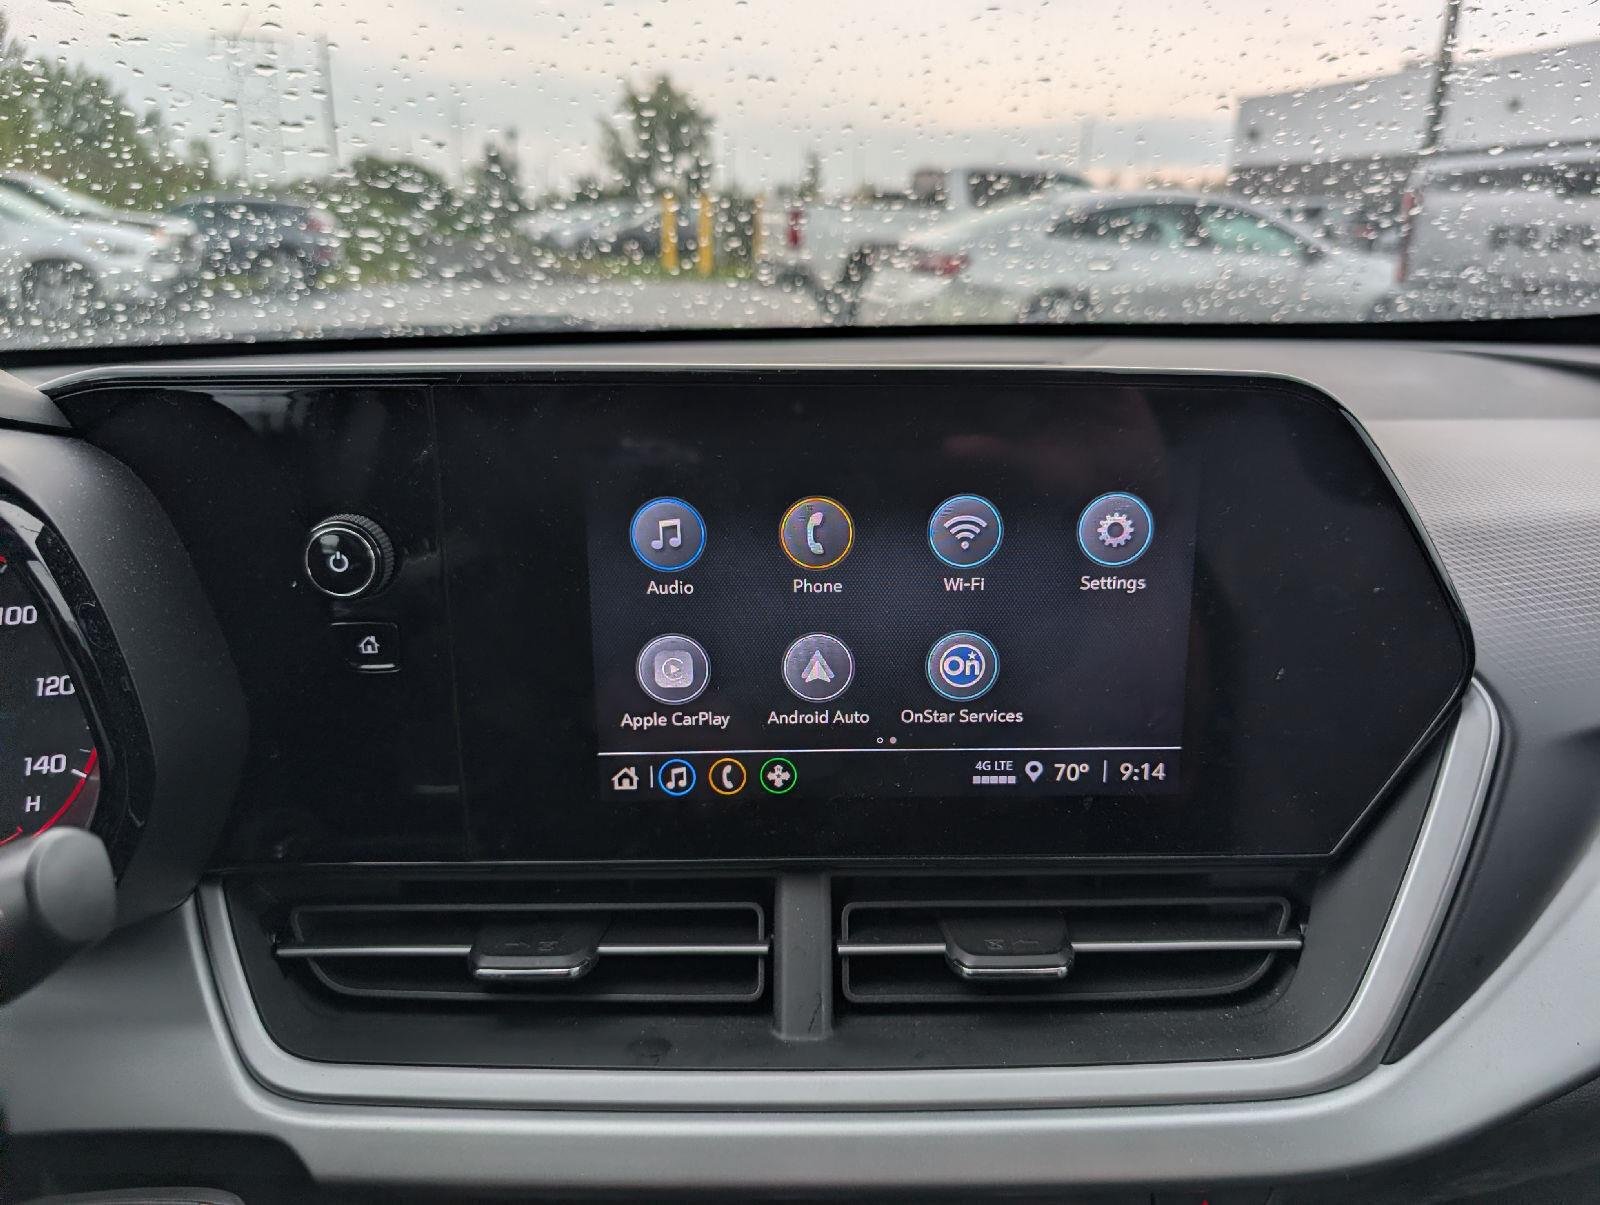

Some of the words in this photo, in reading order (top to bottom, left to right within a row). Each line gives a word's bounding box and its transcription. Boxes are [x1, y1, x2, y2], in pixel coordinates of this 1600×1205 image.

[646, 579, 694, 595] Audio
[793, 578, 843, 594] Phone
[943, 577, 985, 592] Wi-Fi
[1079, 575, 1147, 593] Settings
[943, 655, 980, 676] On
[36, 674, 76, 697] 120
[620, 711, 668, 731] Apple
[671, 711, 731, 730] CarPlay
[767, 709, 829, 725] Android
[832, 710, 870, 724] Auto
[901, 709, 955, 724] OnStar
[959, 708, 1024, 723] Services
[24, 753, 67, 777] 140
[974, 760, 992, 771] 4G
[994, 760, 1014, 771] LTE
[1119, 762, 1166, 782] 9:14
[25, 795, 41, 813] H
